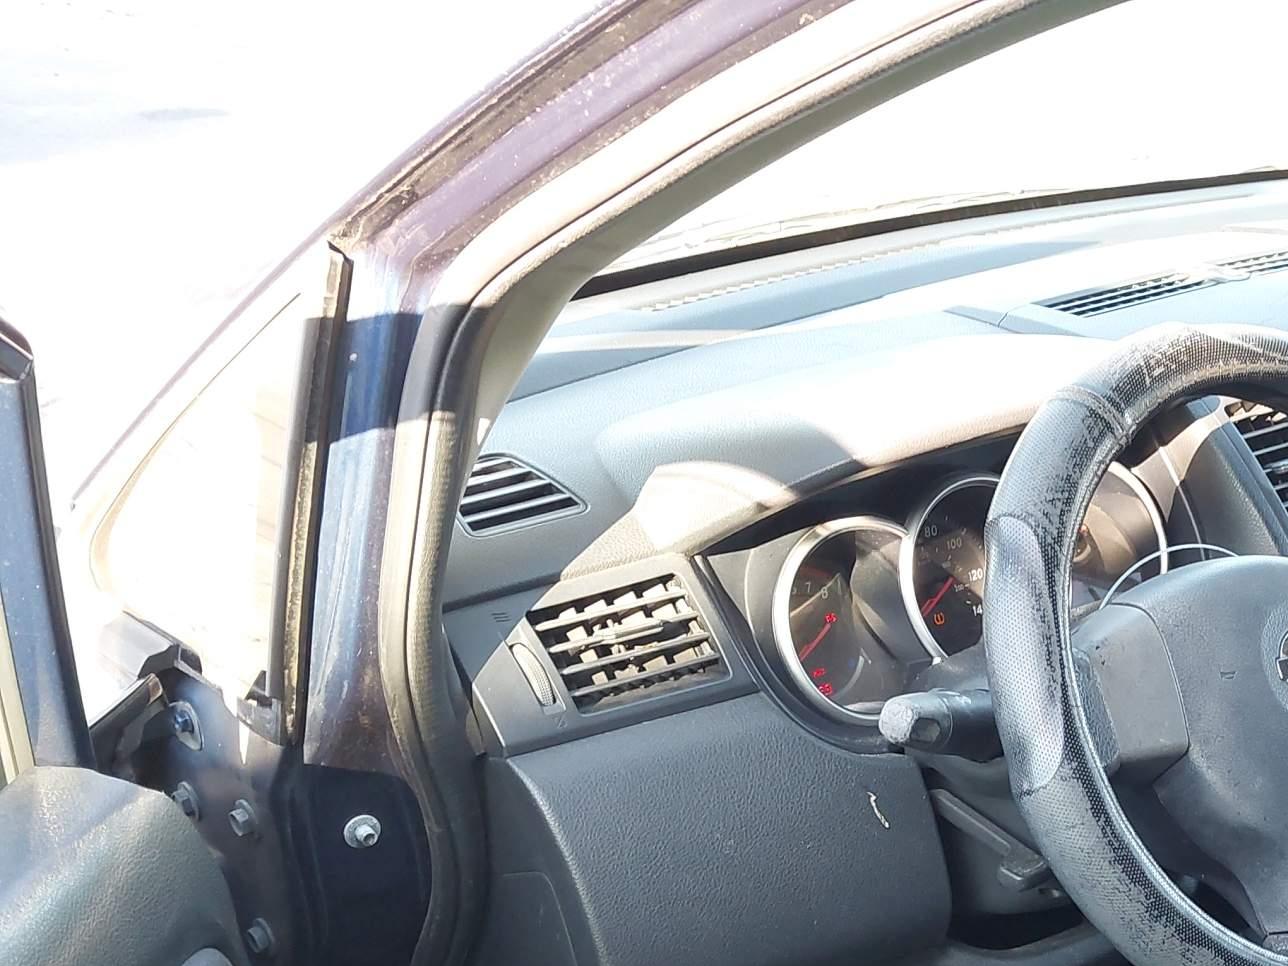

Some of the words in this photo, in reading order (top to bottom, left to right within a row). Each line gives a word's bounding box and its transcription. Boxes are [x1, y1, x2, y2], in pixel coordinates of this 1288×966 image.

[924, 525, 938, 537] 80
[946, 539, 963, 550] 100
[968, 568, 983, 581] 120
[821, 586, 829, 600] 8
[972, 604, 983, 617] 14
